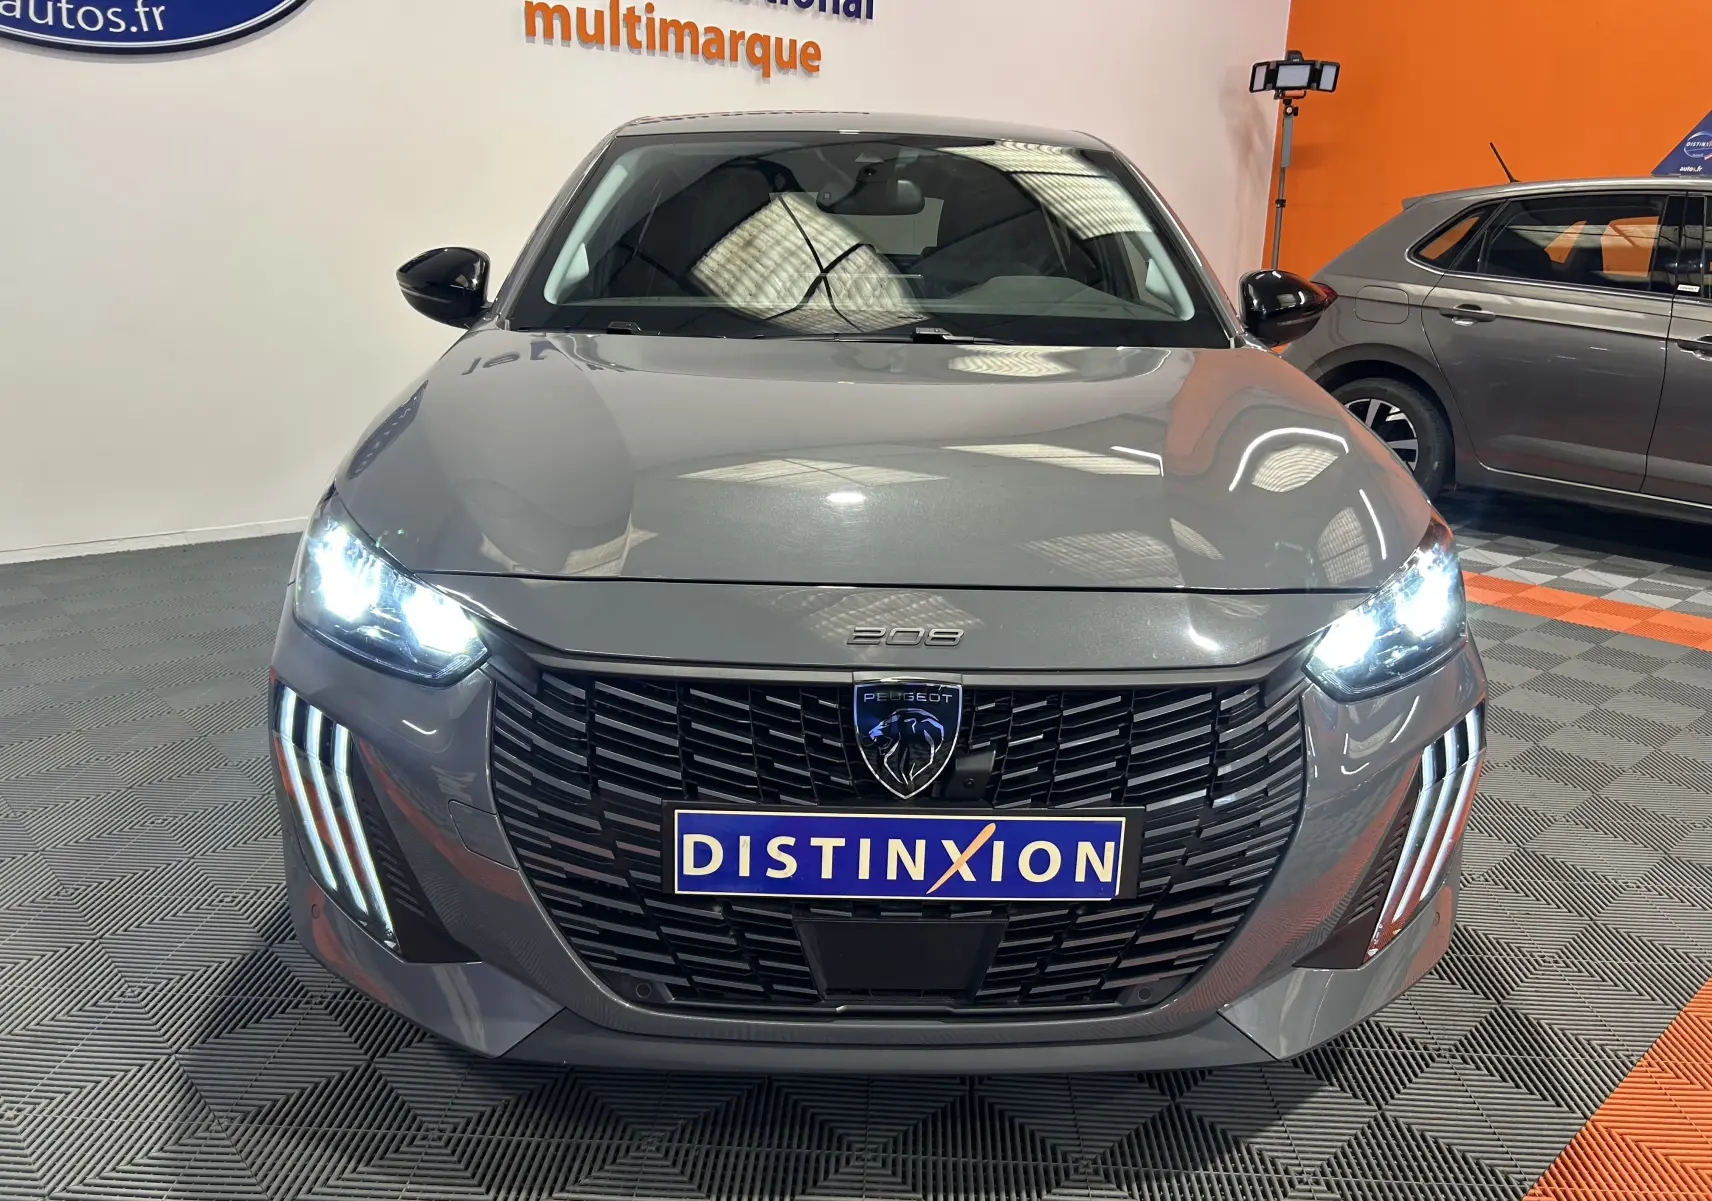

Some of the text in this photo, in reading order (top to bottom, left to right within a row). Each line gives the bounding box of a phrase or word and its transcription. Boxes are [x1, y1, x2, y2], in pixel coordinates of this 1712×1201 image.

[0, 0, 165, 32] autos.fr
[524, 0, 822, 78] multimarque
[847, 626, 965, 646] 208
[863, 691, 953, 703] PEUGEOT
[682, 822, 1116, 894] DISTINXION
